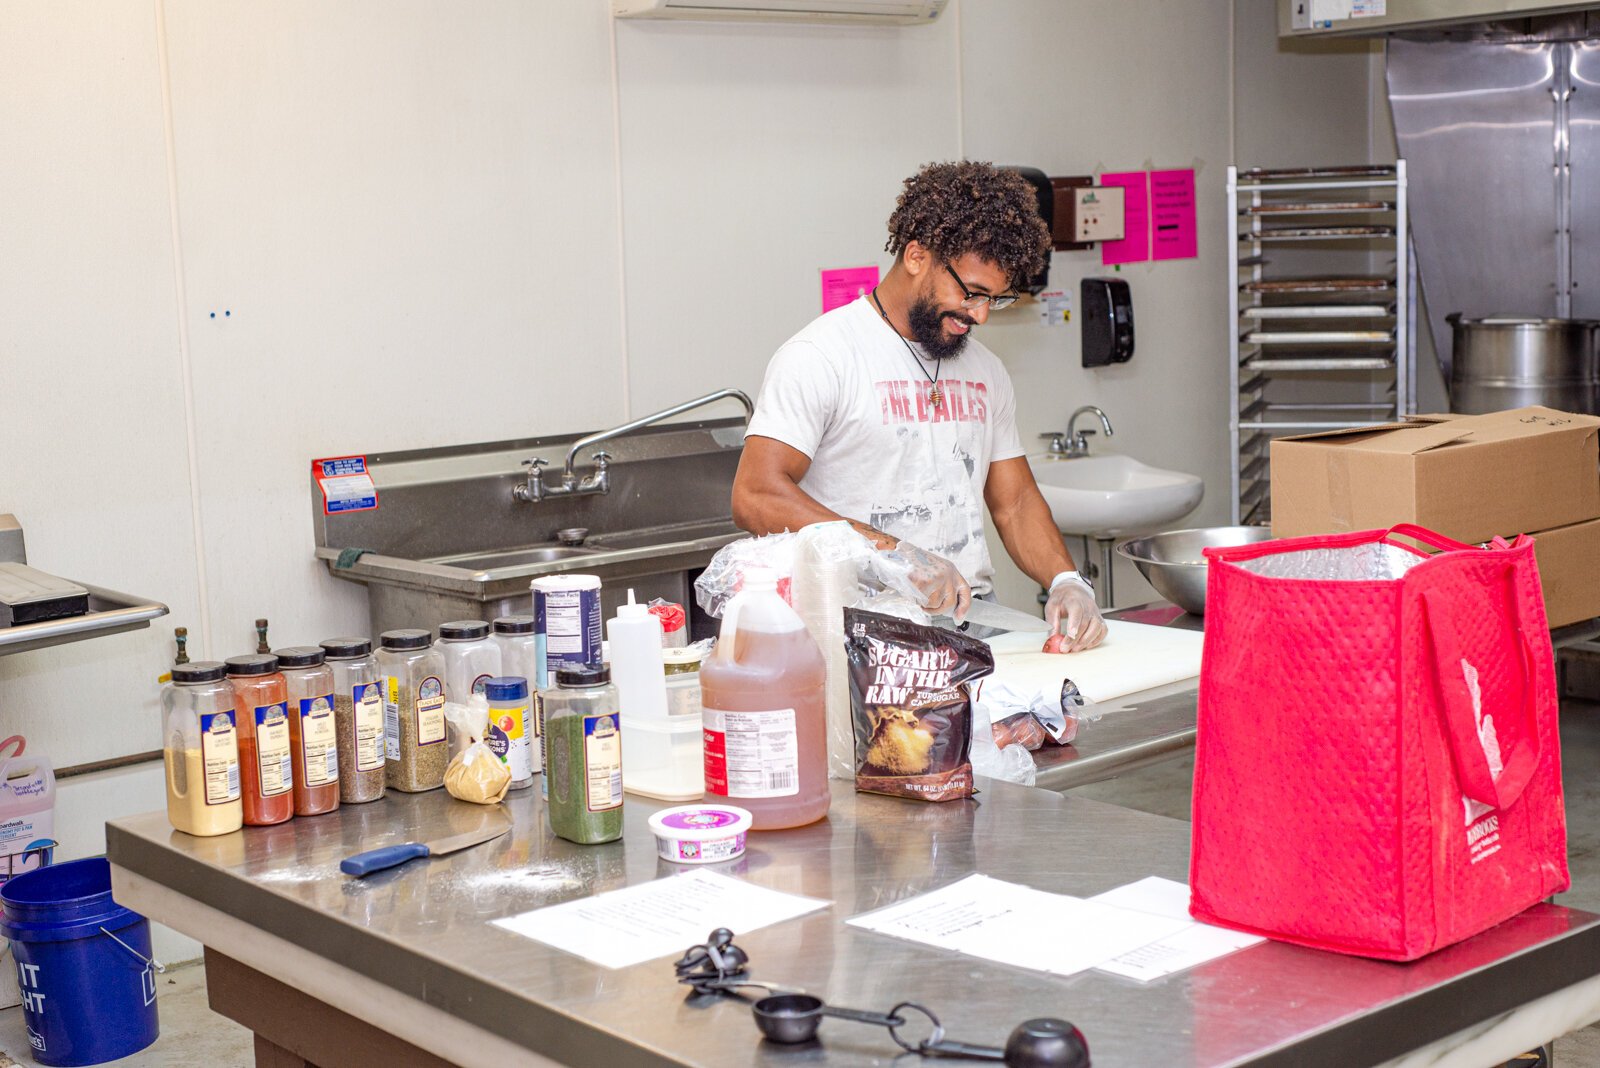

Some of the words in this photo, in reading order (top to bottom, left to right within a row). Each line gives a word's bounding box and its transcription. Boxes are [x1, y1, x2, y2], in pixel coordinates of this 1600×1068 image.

[875, 380, 914, 426] THE
[868, 645, 939, 671] SUGAR
[874, 665, 897, 685] IN
[903, 668, 952, 689] THE
[865, 685, 912, 705] RAW
[0, 820, 24, 829] oardwalk
[19, 962, 41, 989] IT
[21, 991, 46, 1014] HT
